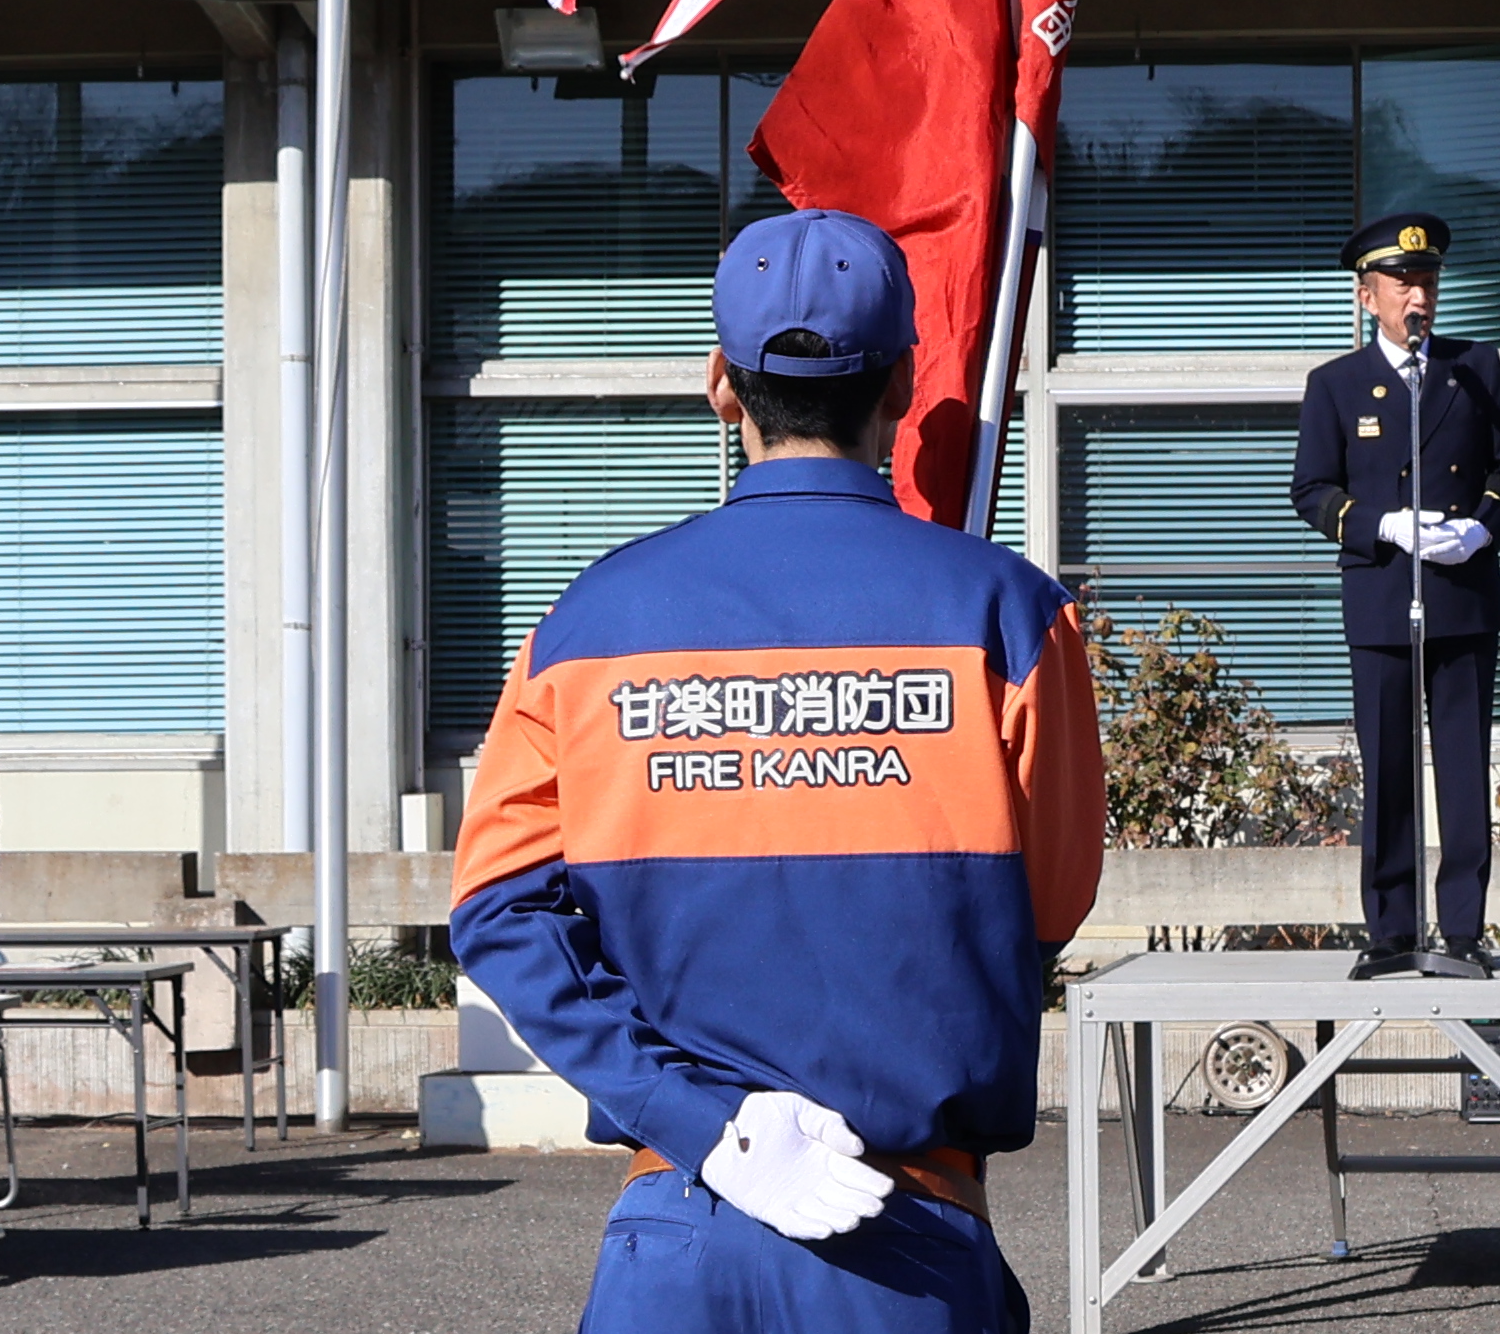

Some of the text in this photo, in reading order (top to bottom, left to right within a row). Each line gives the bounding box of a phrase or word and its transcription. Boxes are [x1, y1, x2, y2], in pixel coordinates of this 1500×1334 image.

[613, 673, 950, 737] 甘楽町消防団
[650, 750, 908, 790] FIRE KANRA
